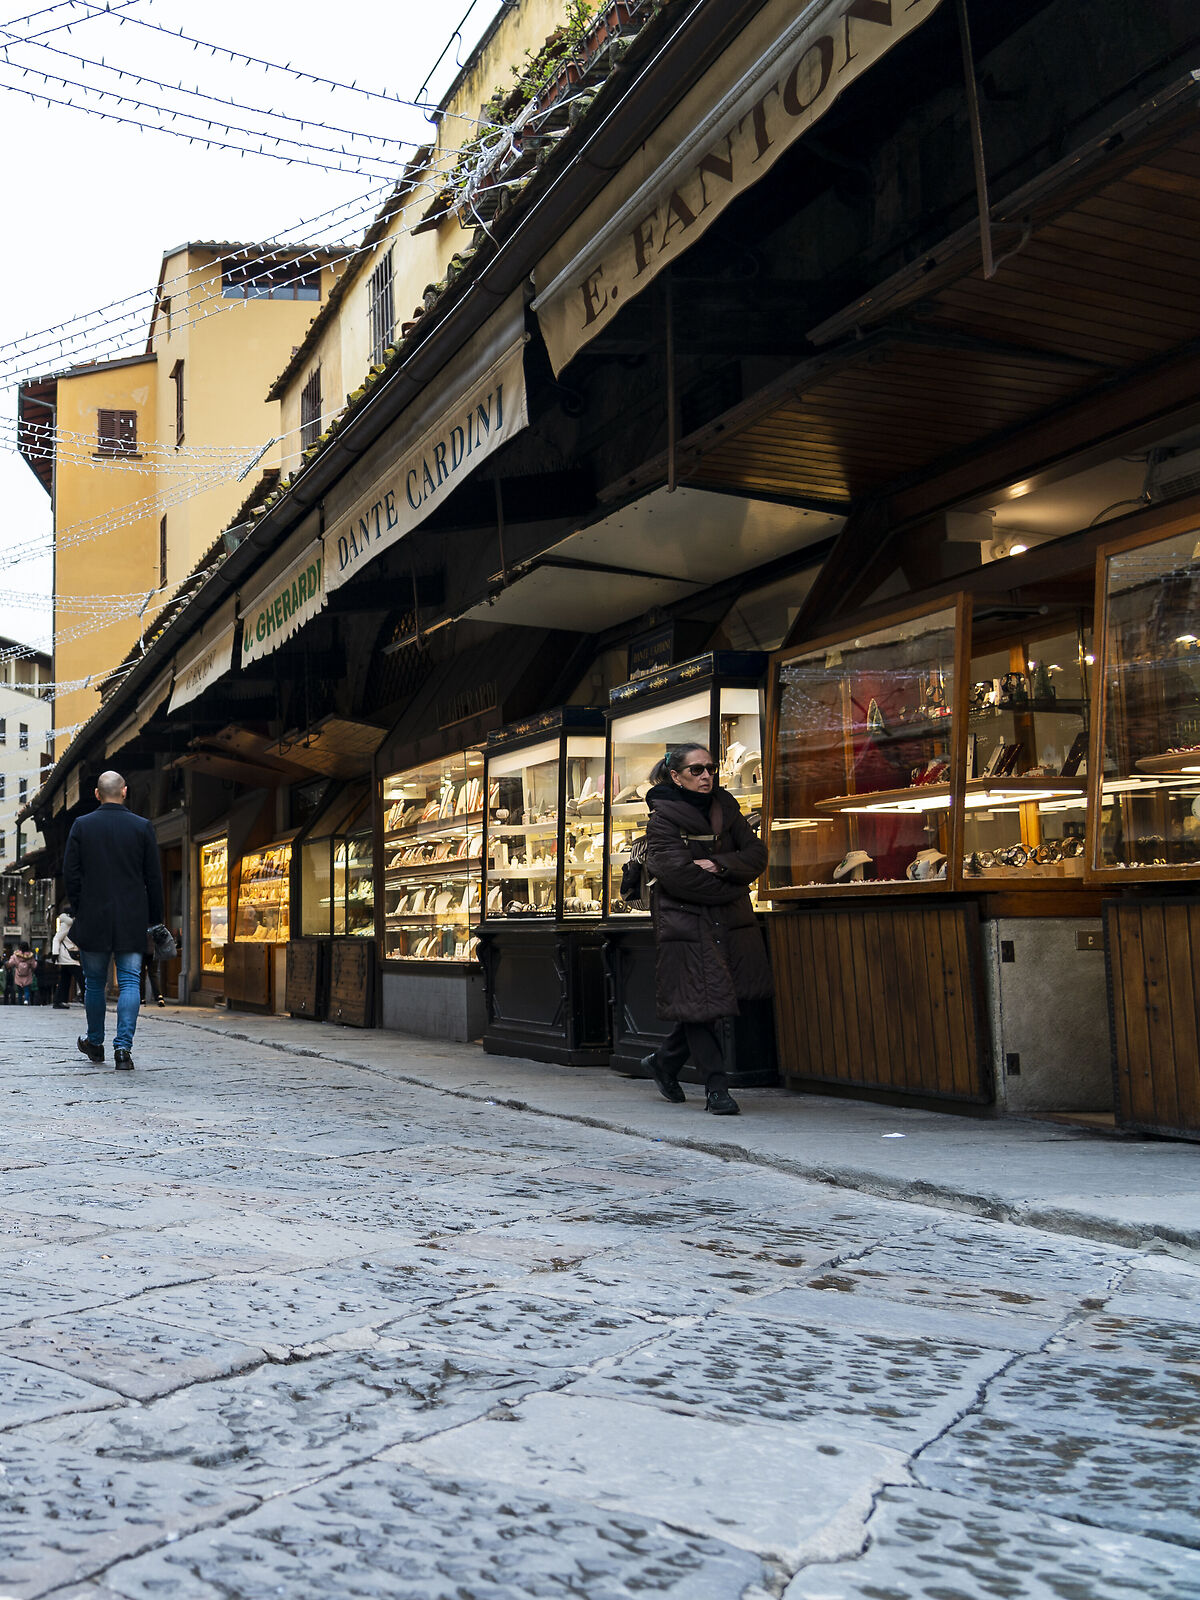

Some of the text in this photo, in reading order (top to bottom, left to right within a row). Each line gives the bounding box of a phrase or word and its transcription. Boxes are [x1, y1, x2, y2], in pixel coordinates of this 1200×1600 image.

[580, 0, 922, 330] E. FANTON
[337, 383, 504, 572] DANTE CARDINI
[256, 557, 322, 643] GHERARDI
